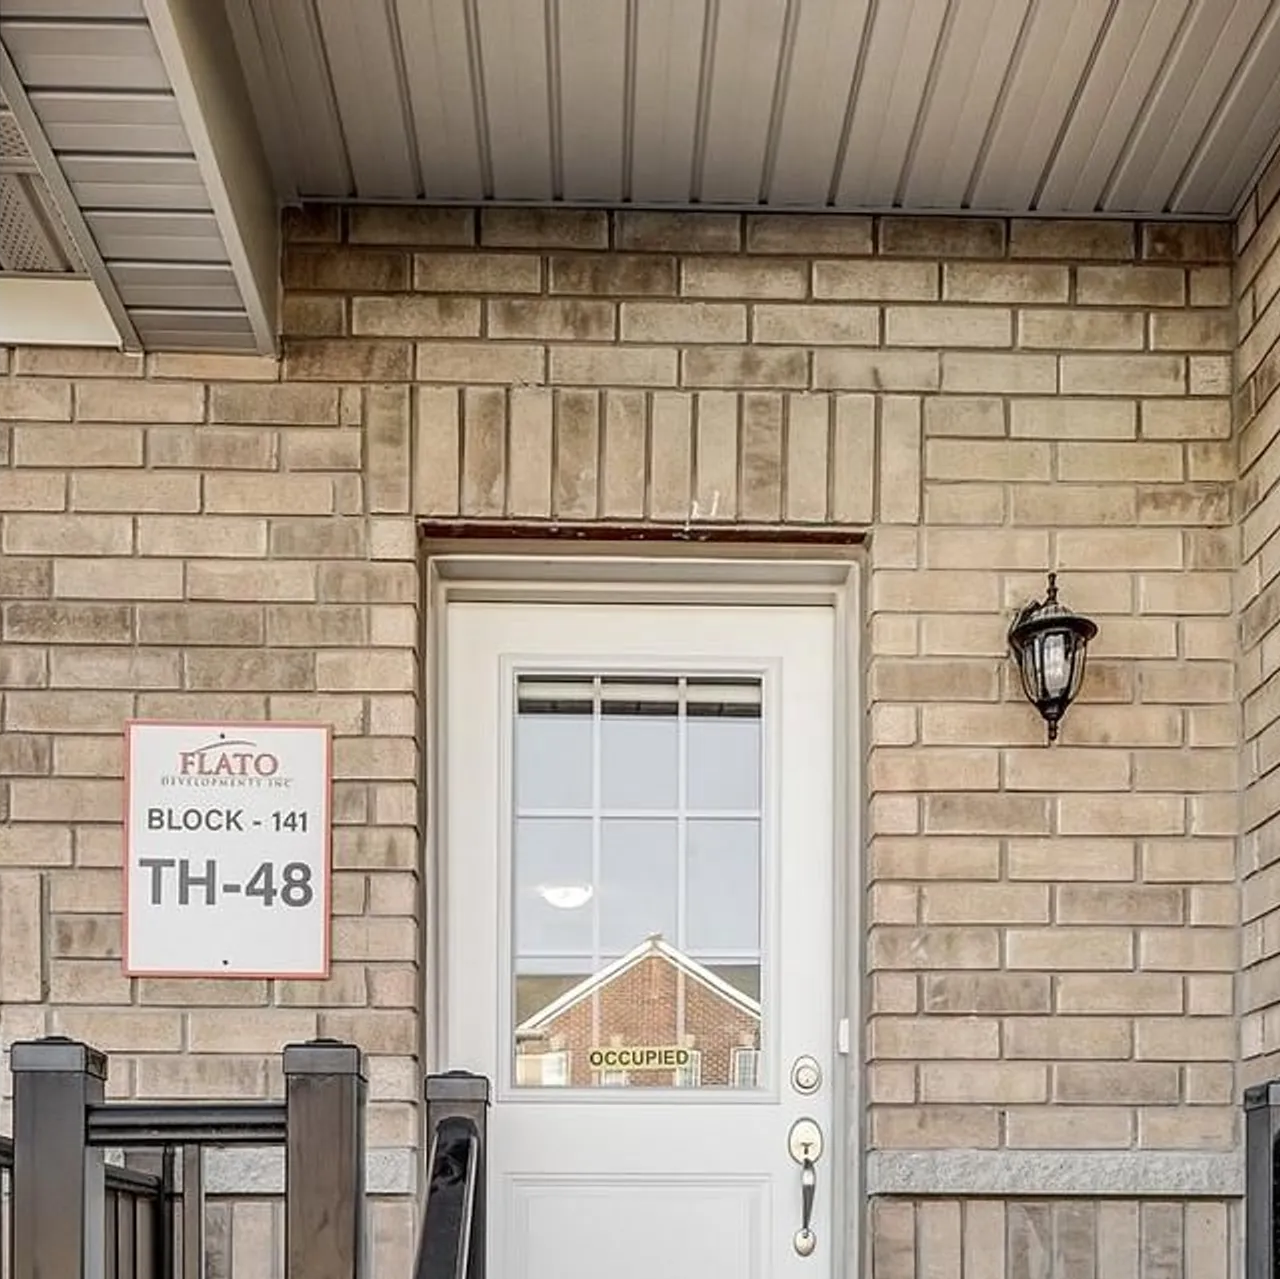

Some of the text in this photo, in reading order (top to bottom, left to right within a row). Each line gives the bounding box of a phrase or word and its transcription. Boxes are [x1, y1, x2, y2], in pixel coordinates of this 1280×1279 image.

[179, 751, 279, 776] FLATO
[147, 808, 244, 831] BLOCK
[272, 811, 308, 832] 141
[138, 858, 314, 907] TH-48
[589, 1049, 689, 1067] OCCUPIED
